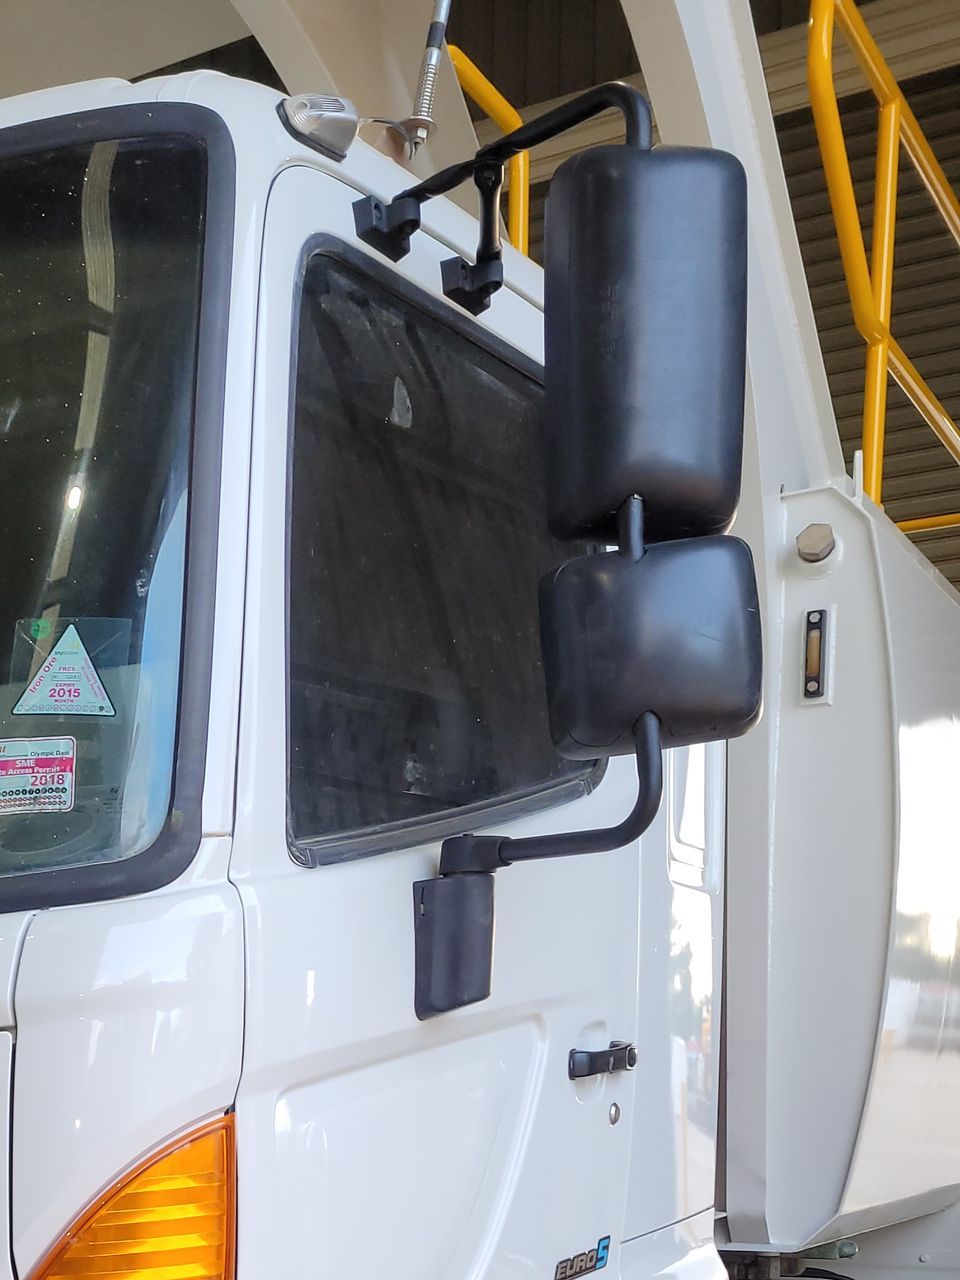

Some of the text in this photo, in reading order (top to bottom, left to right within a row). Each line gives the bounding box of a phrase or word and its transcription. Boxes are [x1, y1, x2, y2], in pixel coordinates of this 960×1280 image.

[28, 674, 45, 694] Iron
[49, 688, 81, 698] 2015
[15, 759, 36, 768] SME
[33, 766, 60, 774] Permit
[30, 773, 65, 787] 2018
